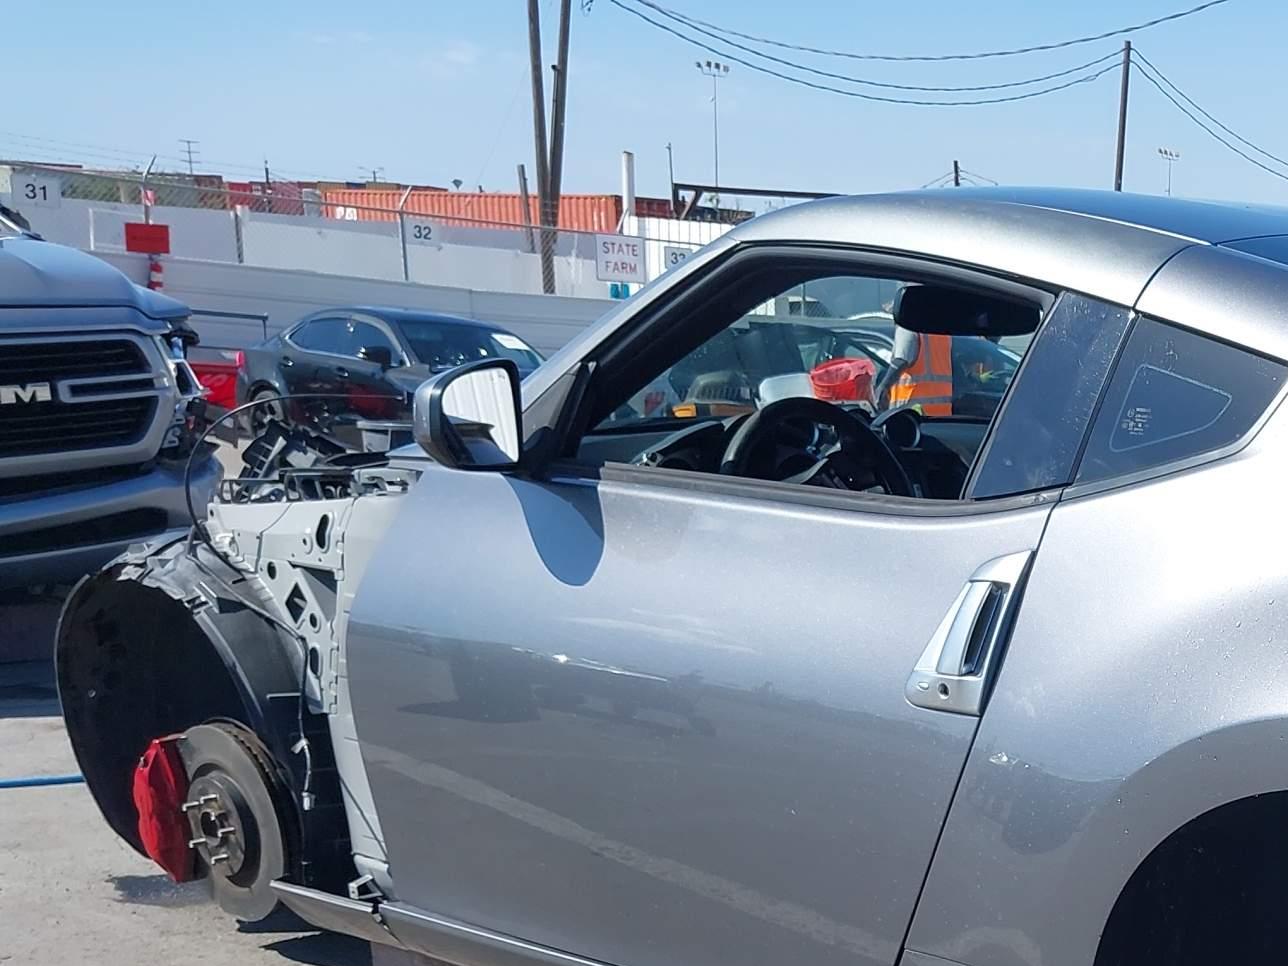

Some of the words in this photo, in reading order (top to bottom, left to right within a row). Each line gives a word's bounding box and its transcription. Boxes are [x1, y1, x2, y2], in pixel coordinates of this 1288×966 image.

[25, 183, 47, 201] 31
[413, 225, 432, 240] 32
[602, 241, 638, 257] STATE
[605, 261, 638, 274] FARM
